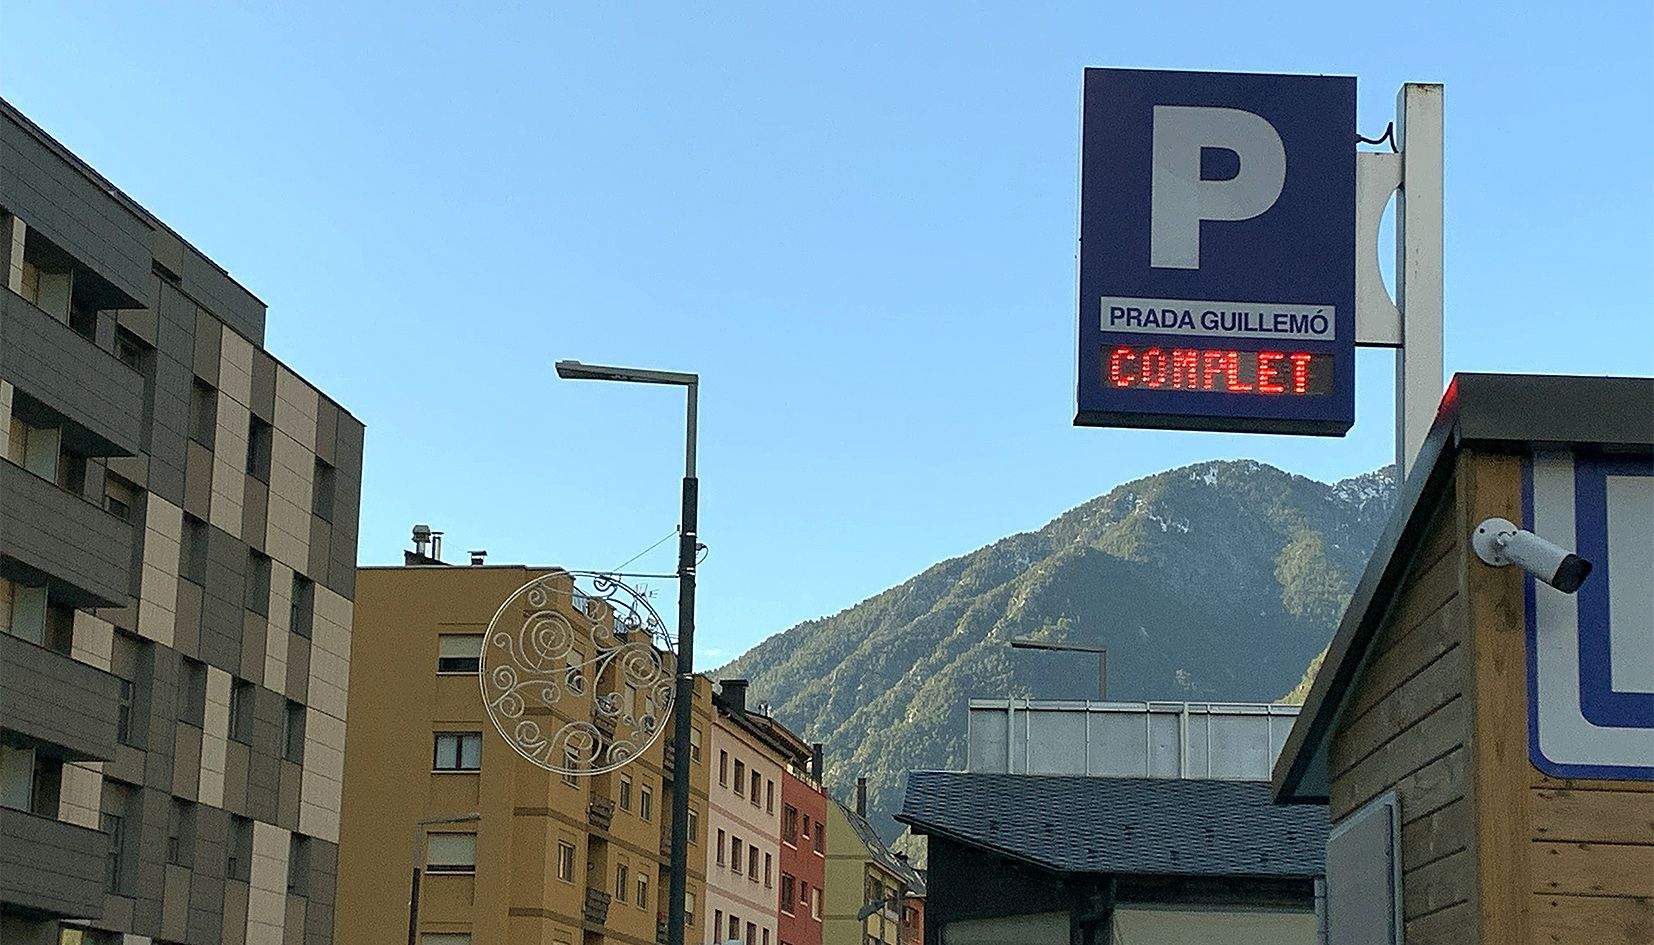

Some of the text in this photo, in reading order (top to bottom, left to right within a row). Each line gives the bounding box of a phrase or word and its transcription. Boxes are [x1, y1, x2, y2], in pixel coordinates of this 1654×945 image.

[1151, 105, 1287, 270] P
[1110, 306, 1329, 335] PRADA GUILLEMÓ
[1110, 347, 1311, 394] COMPLET
